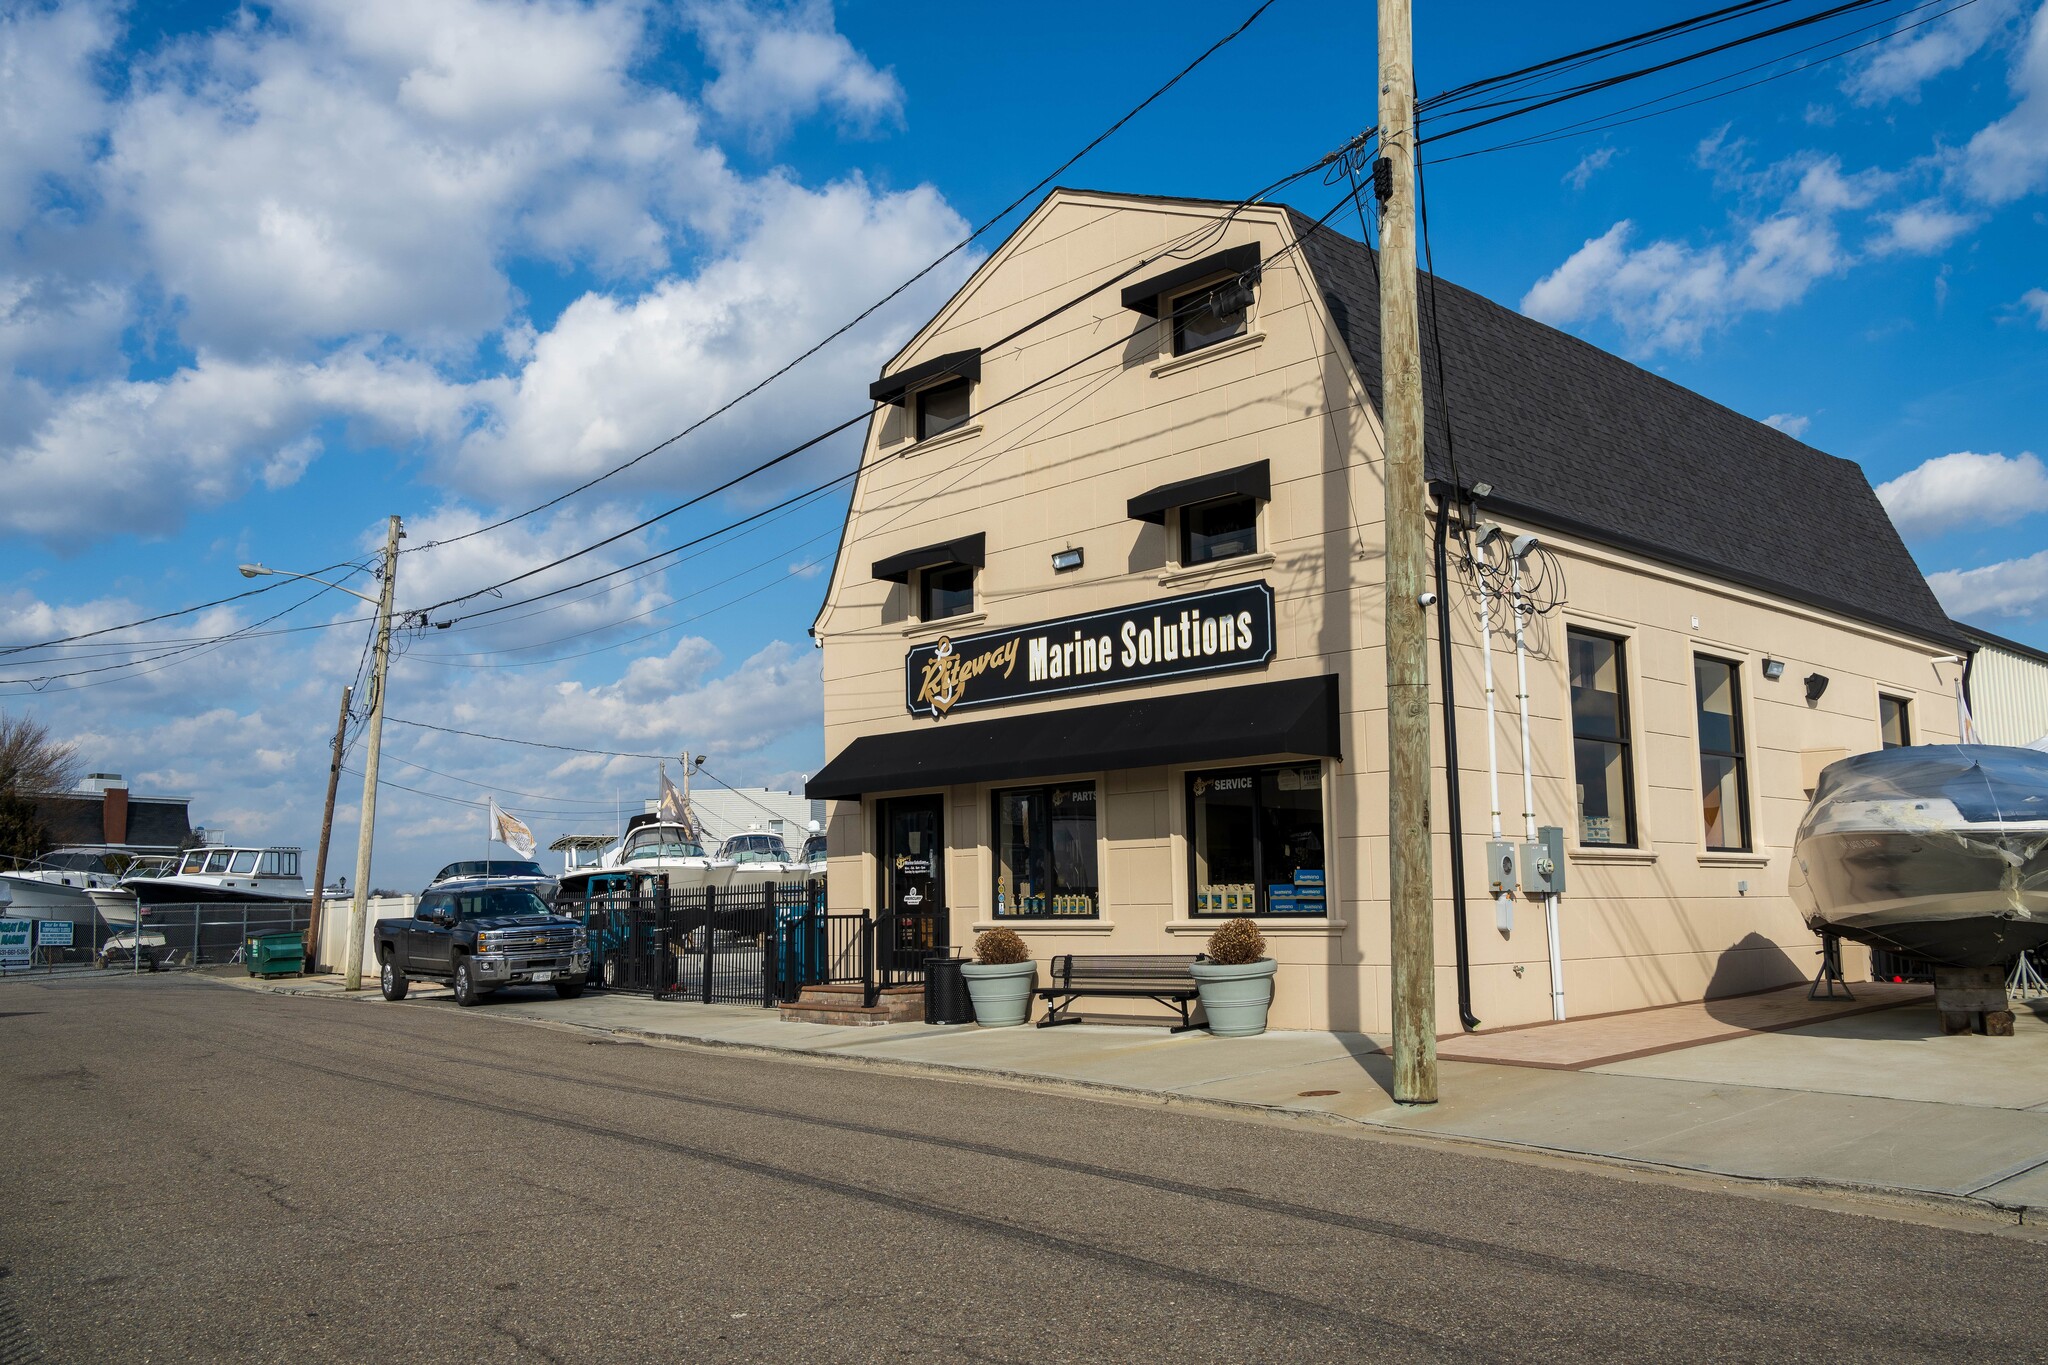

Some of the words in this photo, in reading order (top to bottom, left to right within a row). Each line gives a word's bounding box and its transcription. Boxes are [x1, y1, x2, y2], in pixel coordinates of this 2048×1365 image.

[917, 637, 1021, 701] Riteway
[1028, 631, 1113, 682] Marine
[1121, 609, 1253, 669] Solutions
[1214, 777, 1253, 791] SERVICE
[1072, 791, 1097, 802] PARTS
